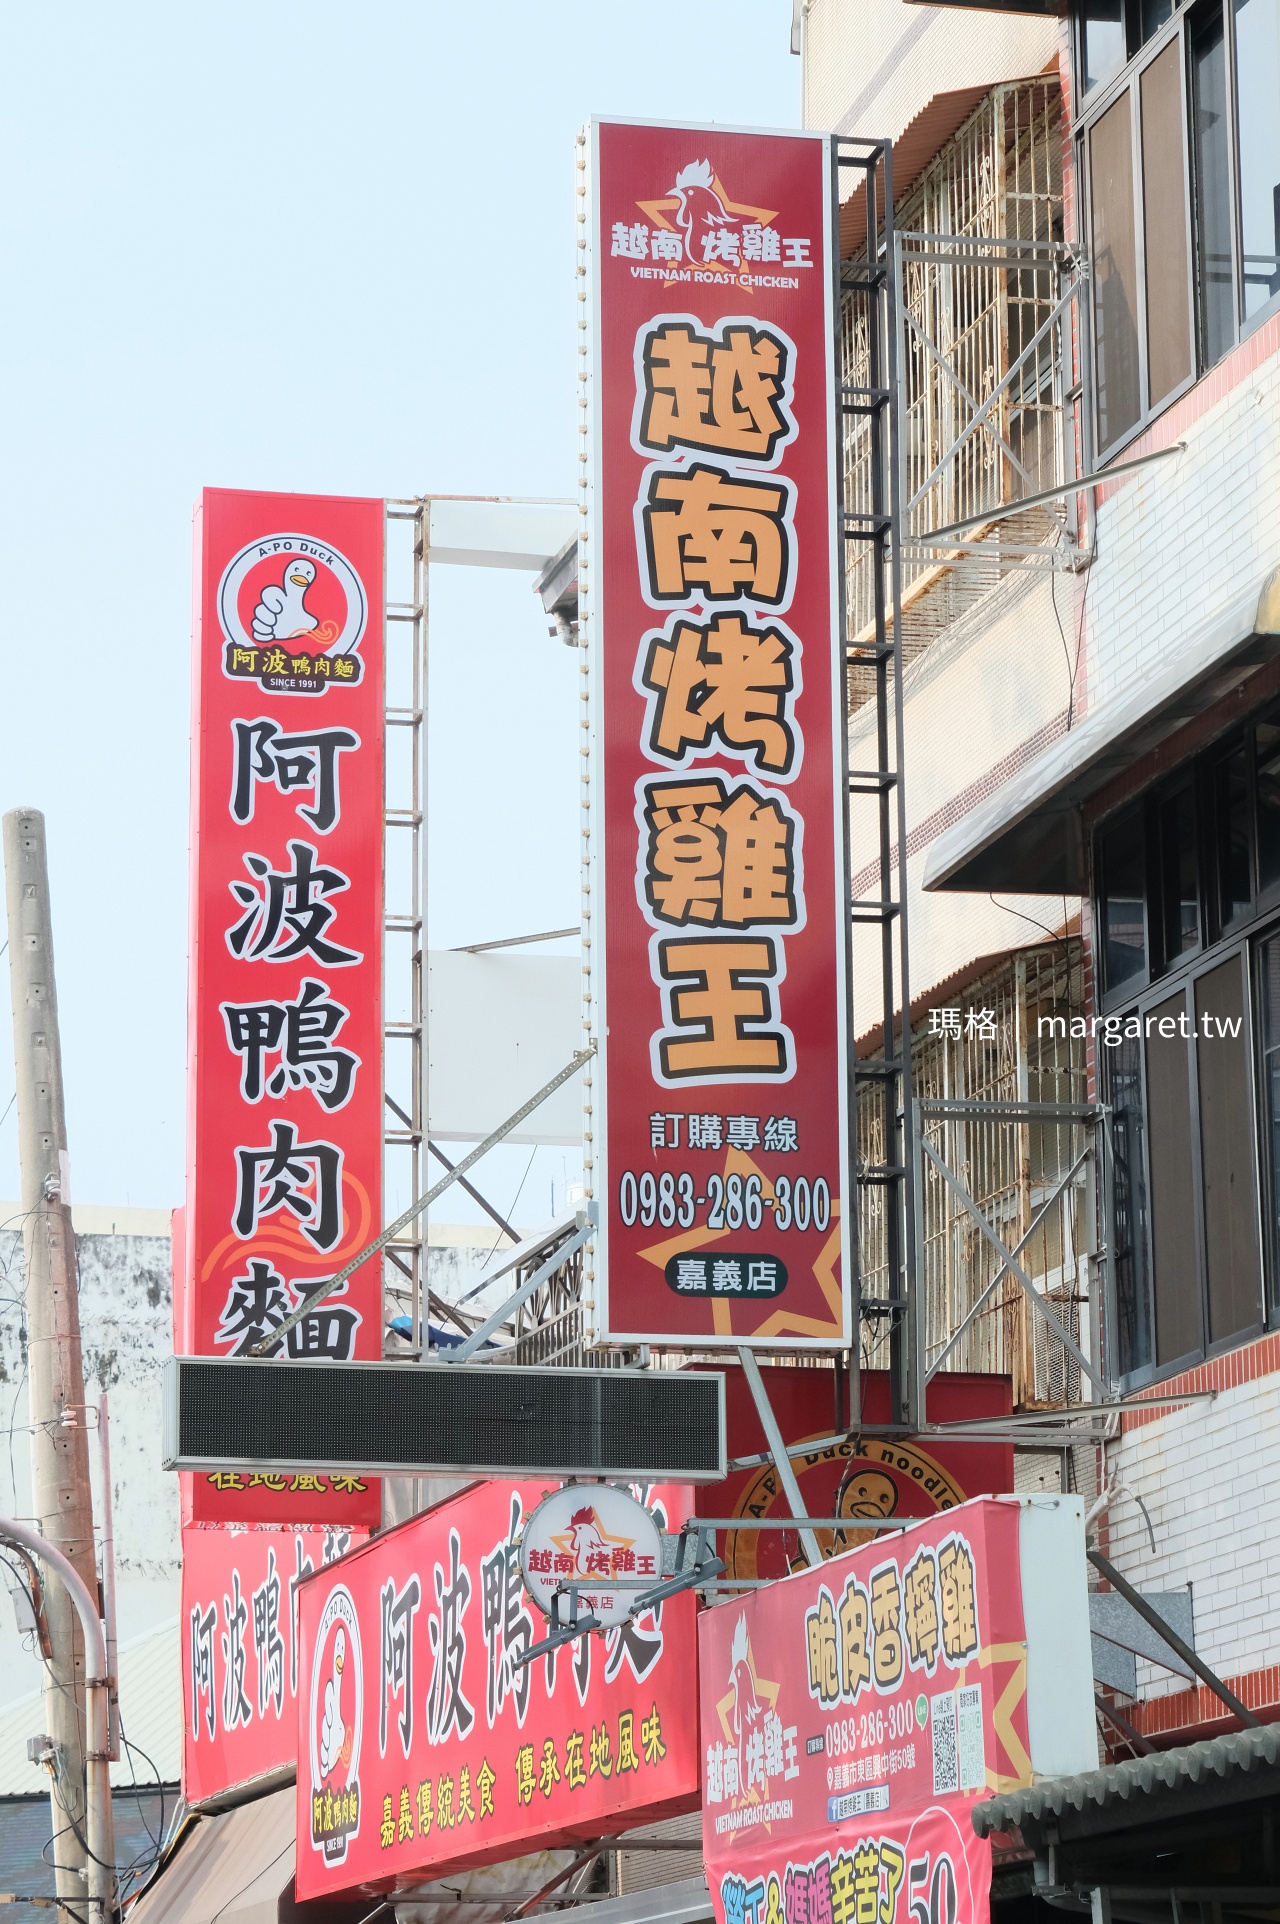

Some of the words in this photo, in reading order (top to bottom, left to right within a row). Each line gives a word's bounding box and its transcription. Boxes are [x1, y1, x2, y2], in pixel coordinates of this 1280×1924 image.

[611, 222, 813, 268] 越南烤雞王
[630, 266, 691, 283] VIETNAM
[694, 271, 737, 285] ROAST
[739, 274, 799, 290] CHICKEN
[258, 541, 293, 558] A-PO
[300, 542, 334, 566] Duck
[232, 648, 355, 678] 阿波鴨肉麵
[270, 677, 296, 688] SINCE
[298, 679, 317, 689] 1991
[634, 318, 803, 1083] 越南烤雞王
[650, 1112, 799, 1152] 訂購專線
[619, 1170, 832, 1233] 0983-286-300
[676, 1259, 778, 1292] 嘉義店
[528, 1546, 657, 1576] 越南烤雞王
[825, 1698, 914, 1758] 0983-286-300
[515, 1702, 667, 1804] 傳承在地風味
[379, 1756, 496, 1850] 嘉義傳統美食
[715, 1810, 743, 1835] VIETNAM
[743, 1804, 764, 1827] ROAST
[764, 1799, 793, 1822] CHICKEN
